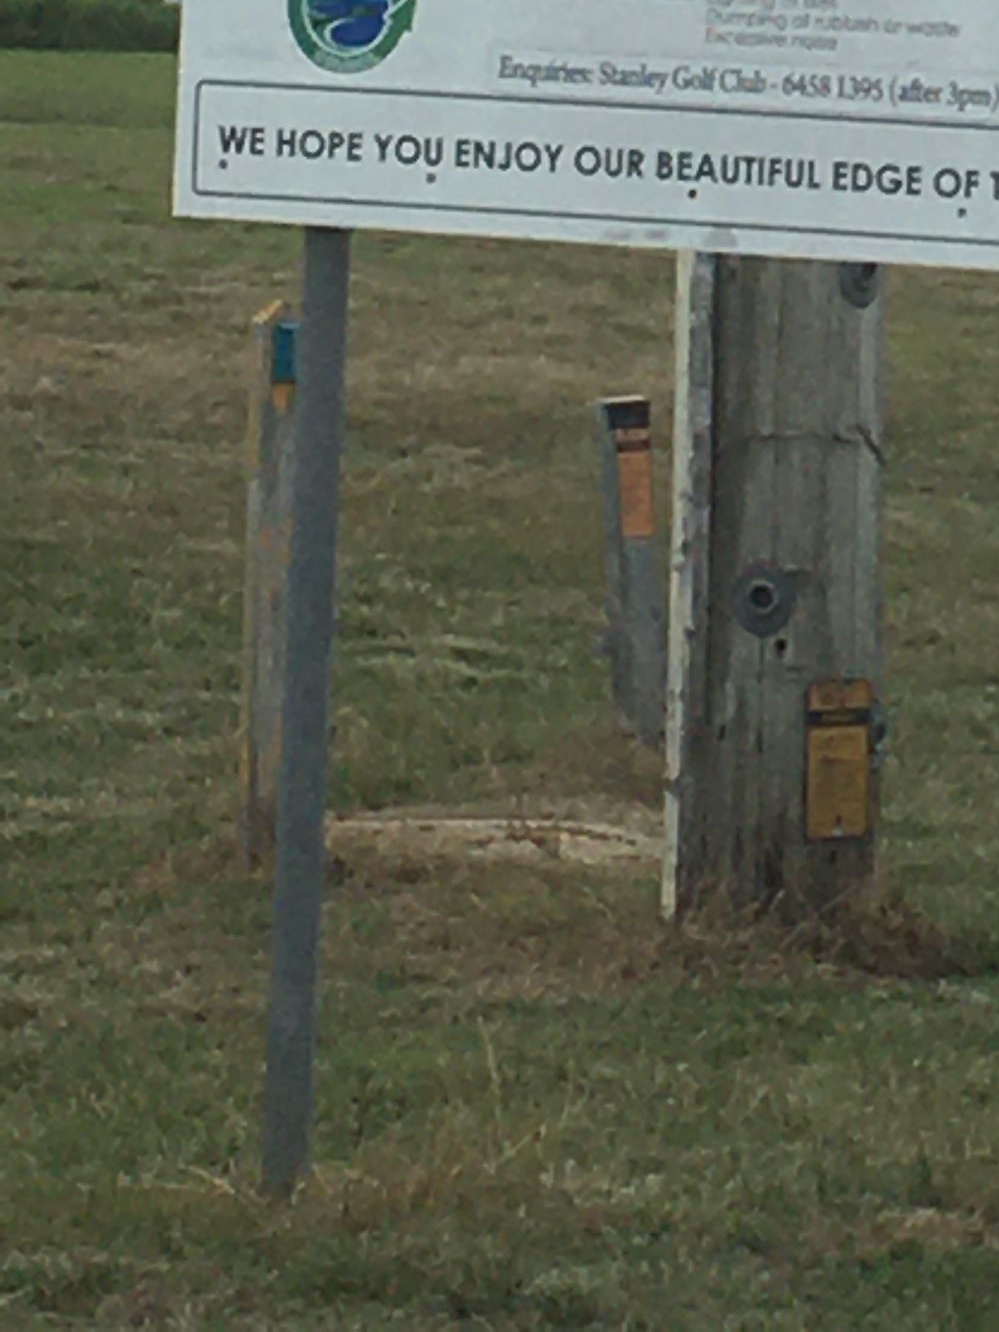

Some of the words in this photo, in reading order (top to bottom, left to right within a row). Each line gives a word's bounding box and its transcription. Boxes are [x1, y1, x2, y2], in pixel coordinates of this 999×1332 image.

[599, 61, 668, 94] Stanley
[672, 64, 717, 92] Golf
[720, 67, 766, 94] Club
[782, 72, 831, 98] 6458
[838, 75, 883, 102] 1395
[889, 75, 943, 108] (after
[218, 125, 265, 156] WE
[276, 129, 364, 162] HOPE
[374, 134, 444, 166] YOU
[454, 139, 564, 172] ENJOY
[574, 145, 645, 178] OUR
[656, 150, 821, 188] BEAUTIFUL
[831, 162, 922, 197] EDGE
[932, 168, 980, 199] OF
